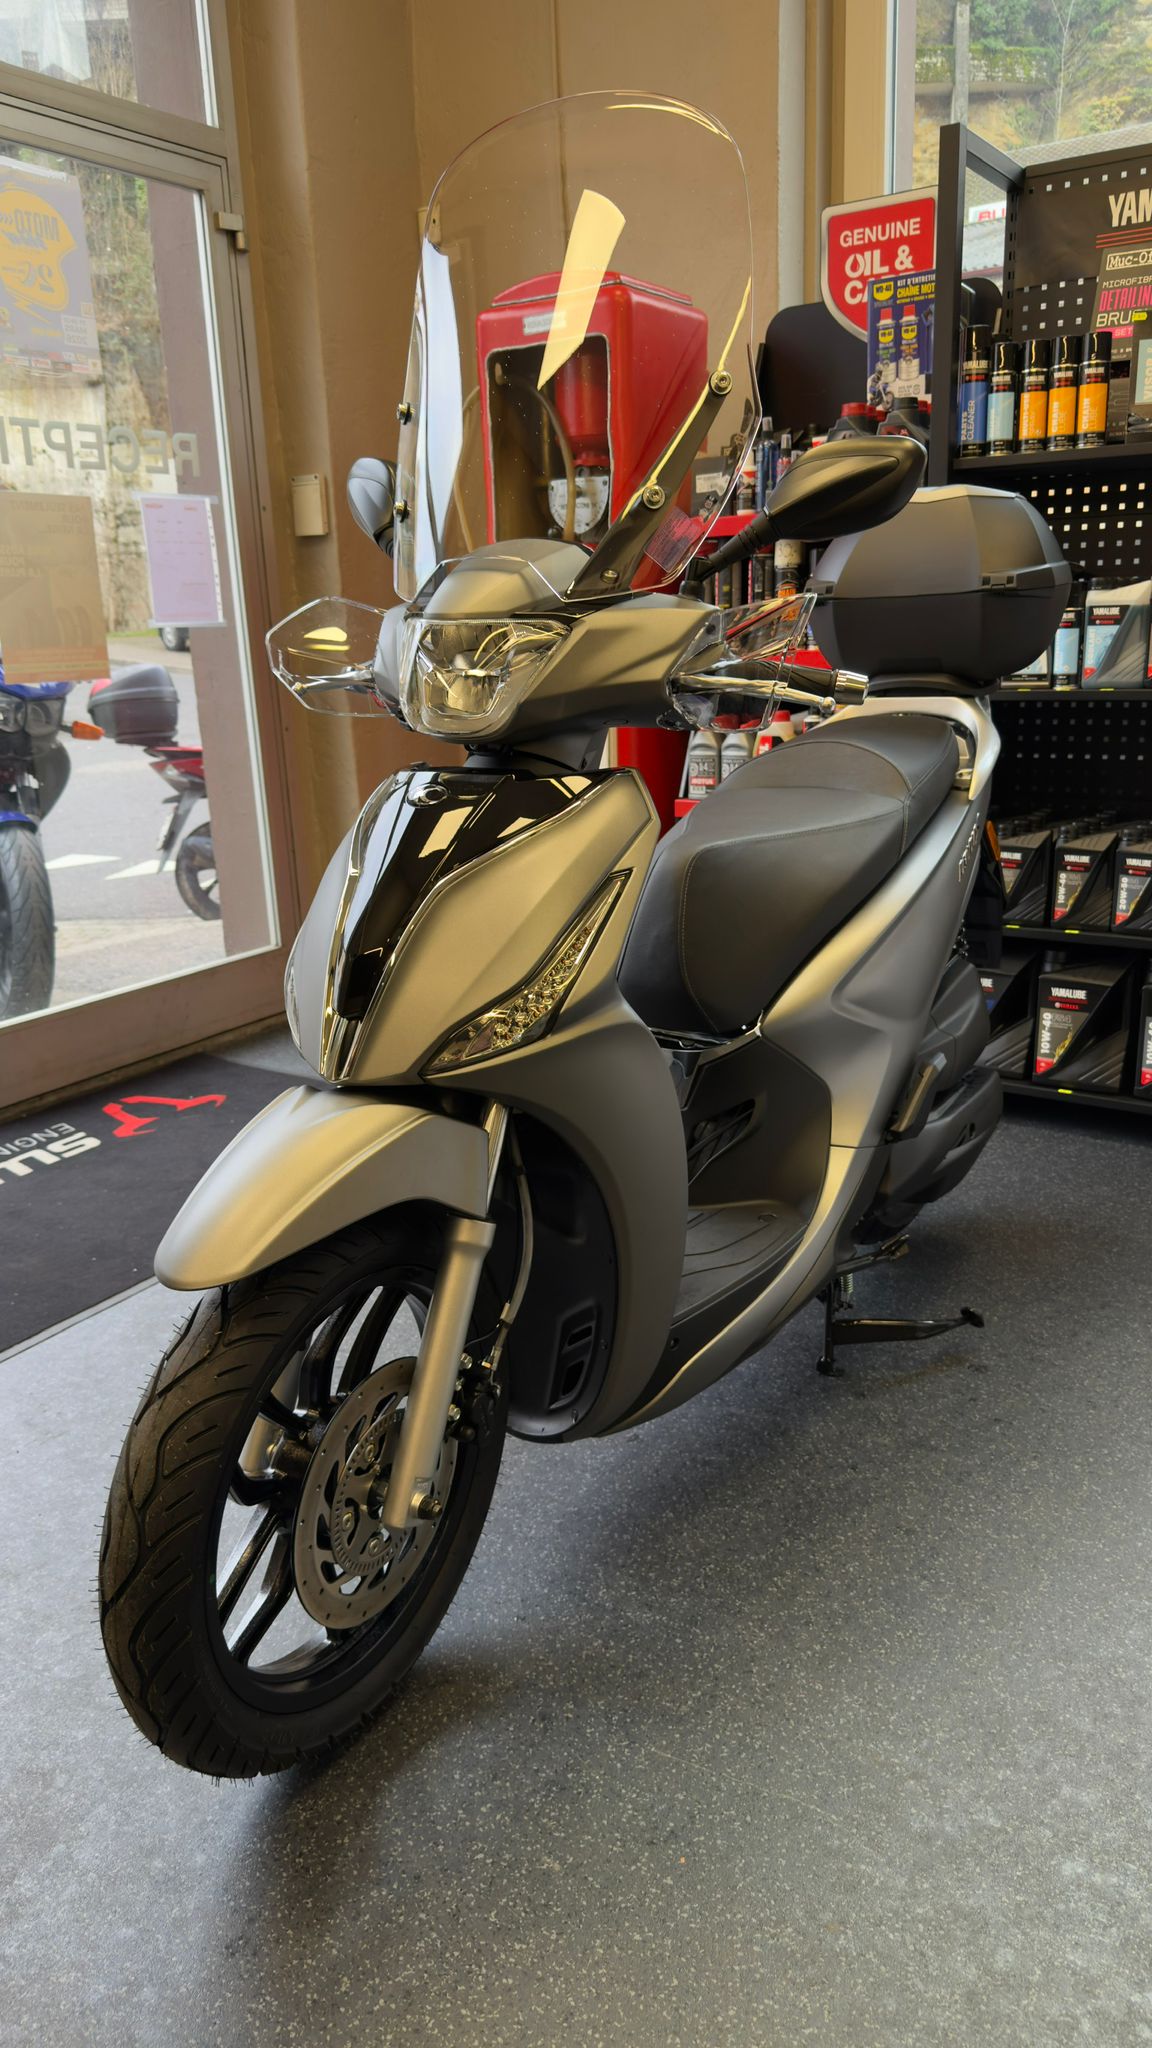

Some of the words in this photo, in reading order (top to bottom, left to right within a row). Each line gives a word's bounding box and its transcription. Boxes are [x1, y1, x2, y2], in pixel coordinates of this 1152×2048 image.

[1108, 188, 1152, 228] YAM
[840, 217, 921, 248] GENUINE
[844, 249, 889, 278] OIL
[895, 245, 915, 271] &
[875, 283, 893, 294] WD-40
[897, 278, 906, 287] KIT
[1096, 308, 1140, 328] BRU
[967, 400, 975, 440] CLEANER
[1081, 398, 1090, 430] CHAIN
[1092, 606, 1121, 616] YAMALUBE
[1063, 854, 1091, 864] YAMALUBE
[1057, 872, 1067, 904] 10W-40
[1119, 877, 1129, 911] 20W-50
[1050, 986, 1088, 1000] YAMALUBE
[1040, 1012, 1052, 1055] 10W-40
